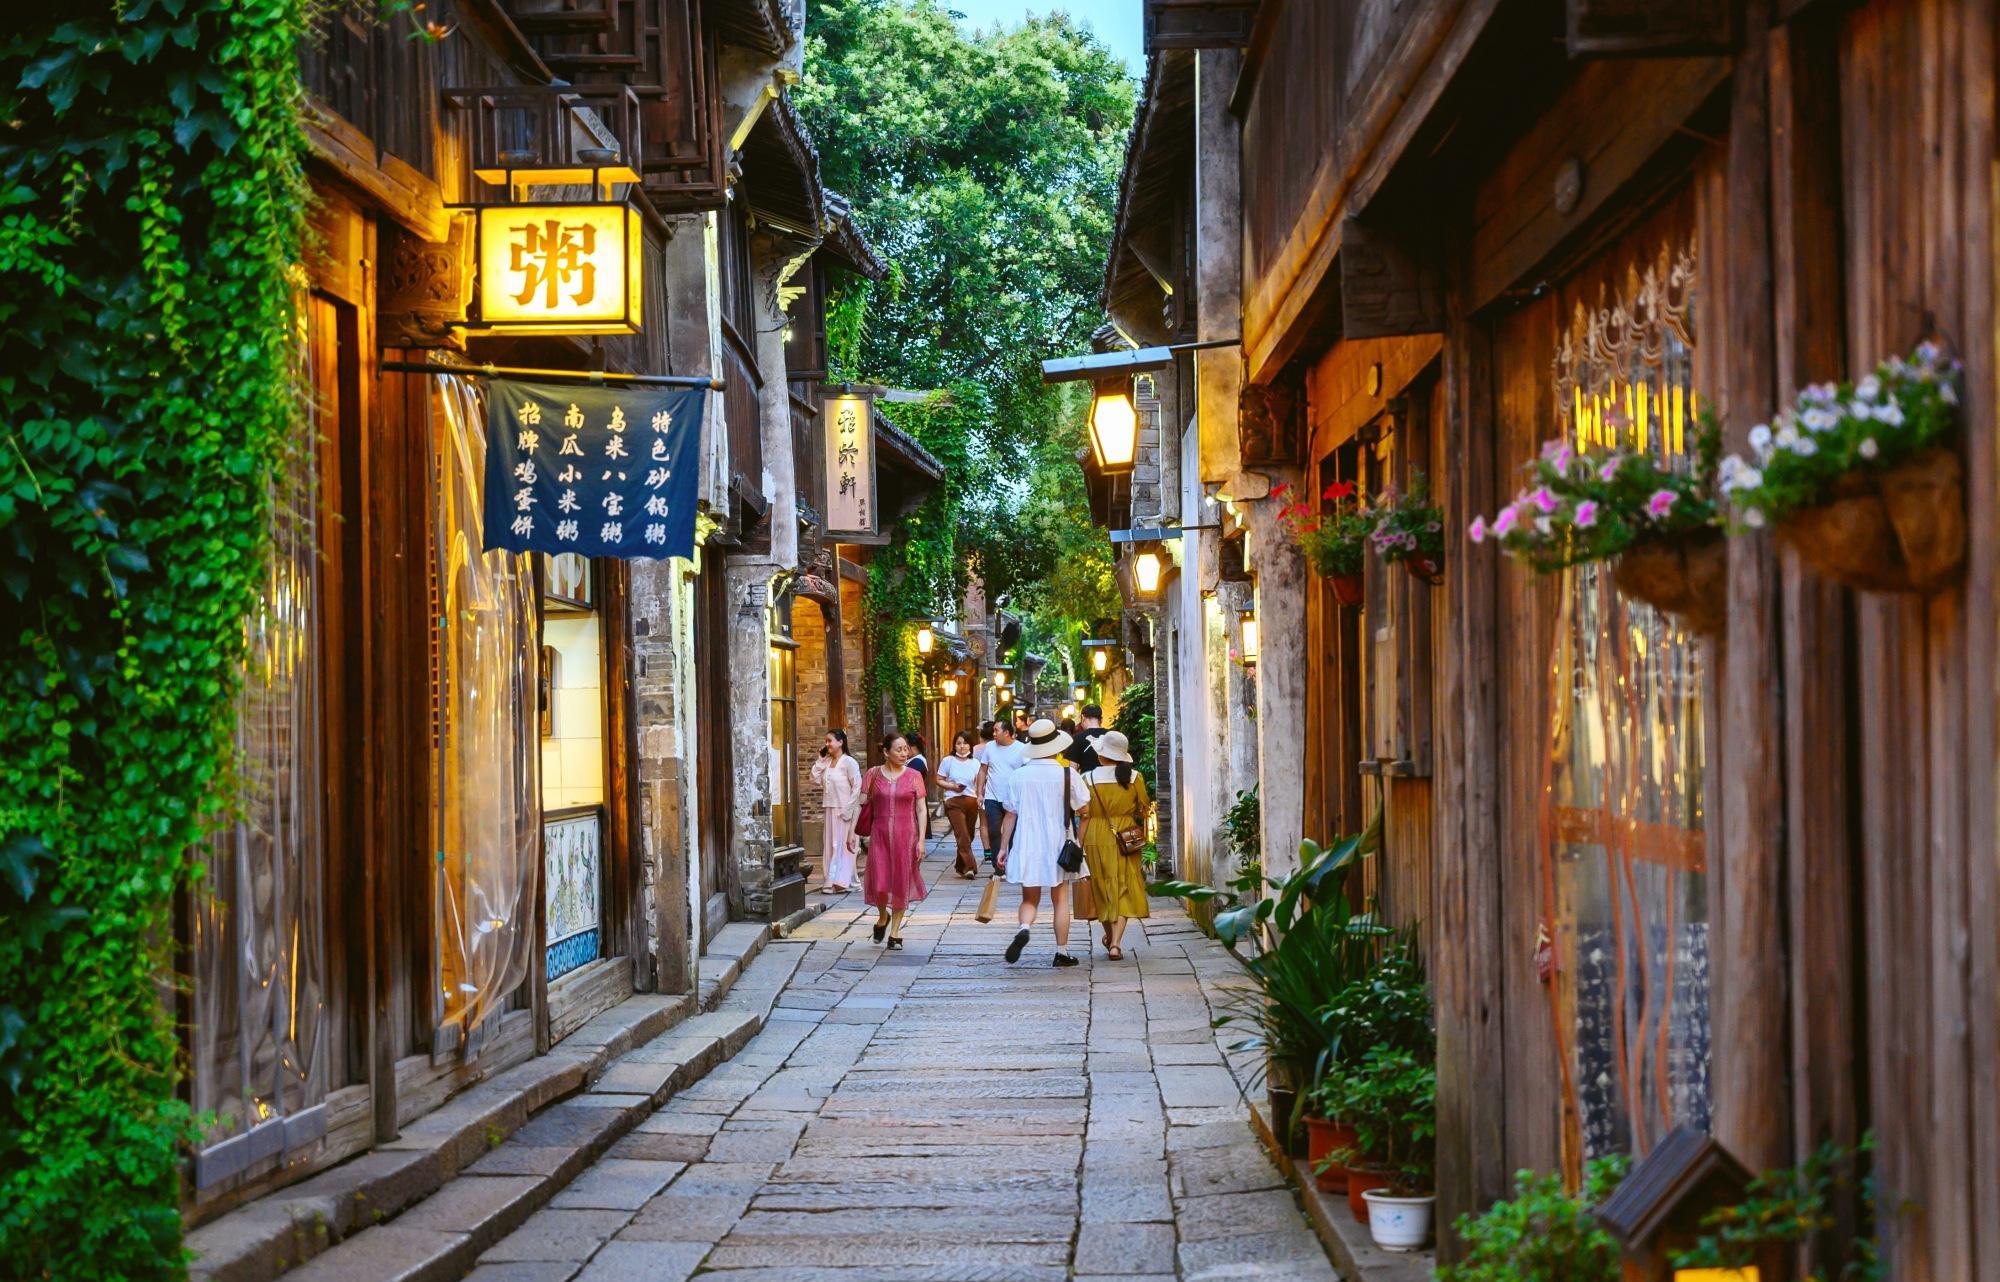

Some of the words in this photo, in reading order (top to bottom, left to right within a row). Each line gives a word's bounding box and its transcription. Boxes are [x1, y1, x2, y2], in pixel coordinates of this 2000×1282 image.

[509, 220, 596, 309] 粥
[510, 401, 541, 540] 招牌鸡蛋饼
[556, 403, 585, 542] 南瓜小米粥
[600, 405, 629, 544] 乌米八宝粥
[644, 410, 673, 545] 特色砂锅粥
